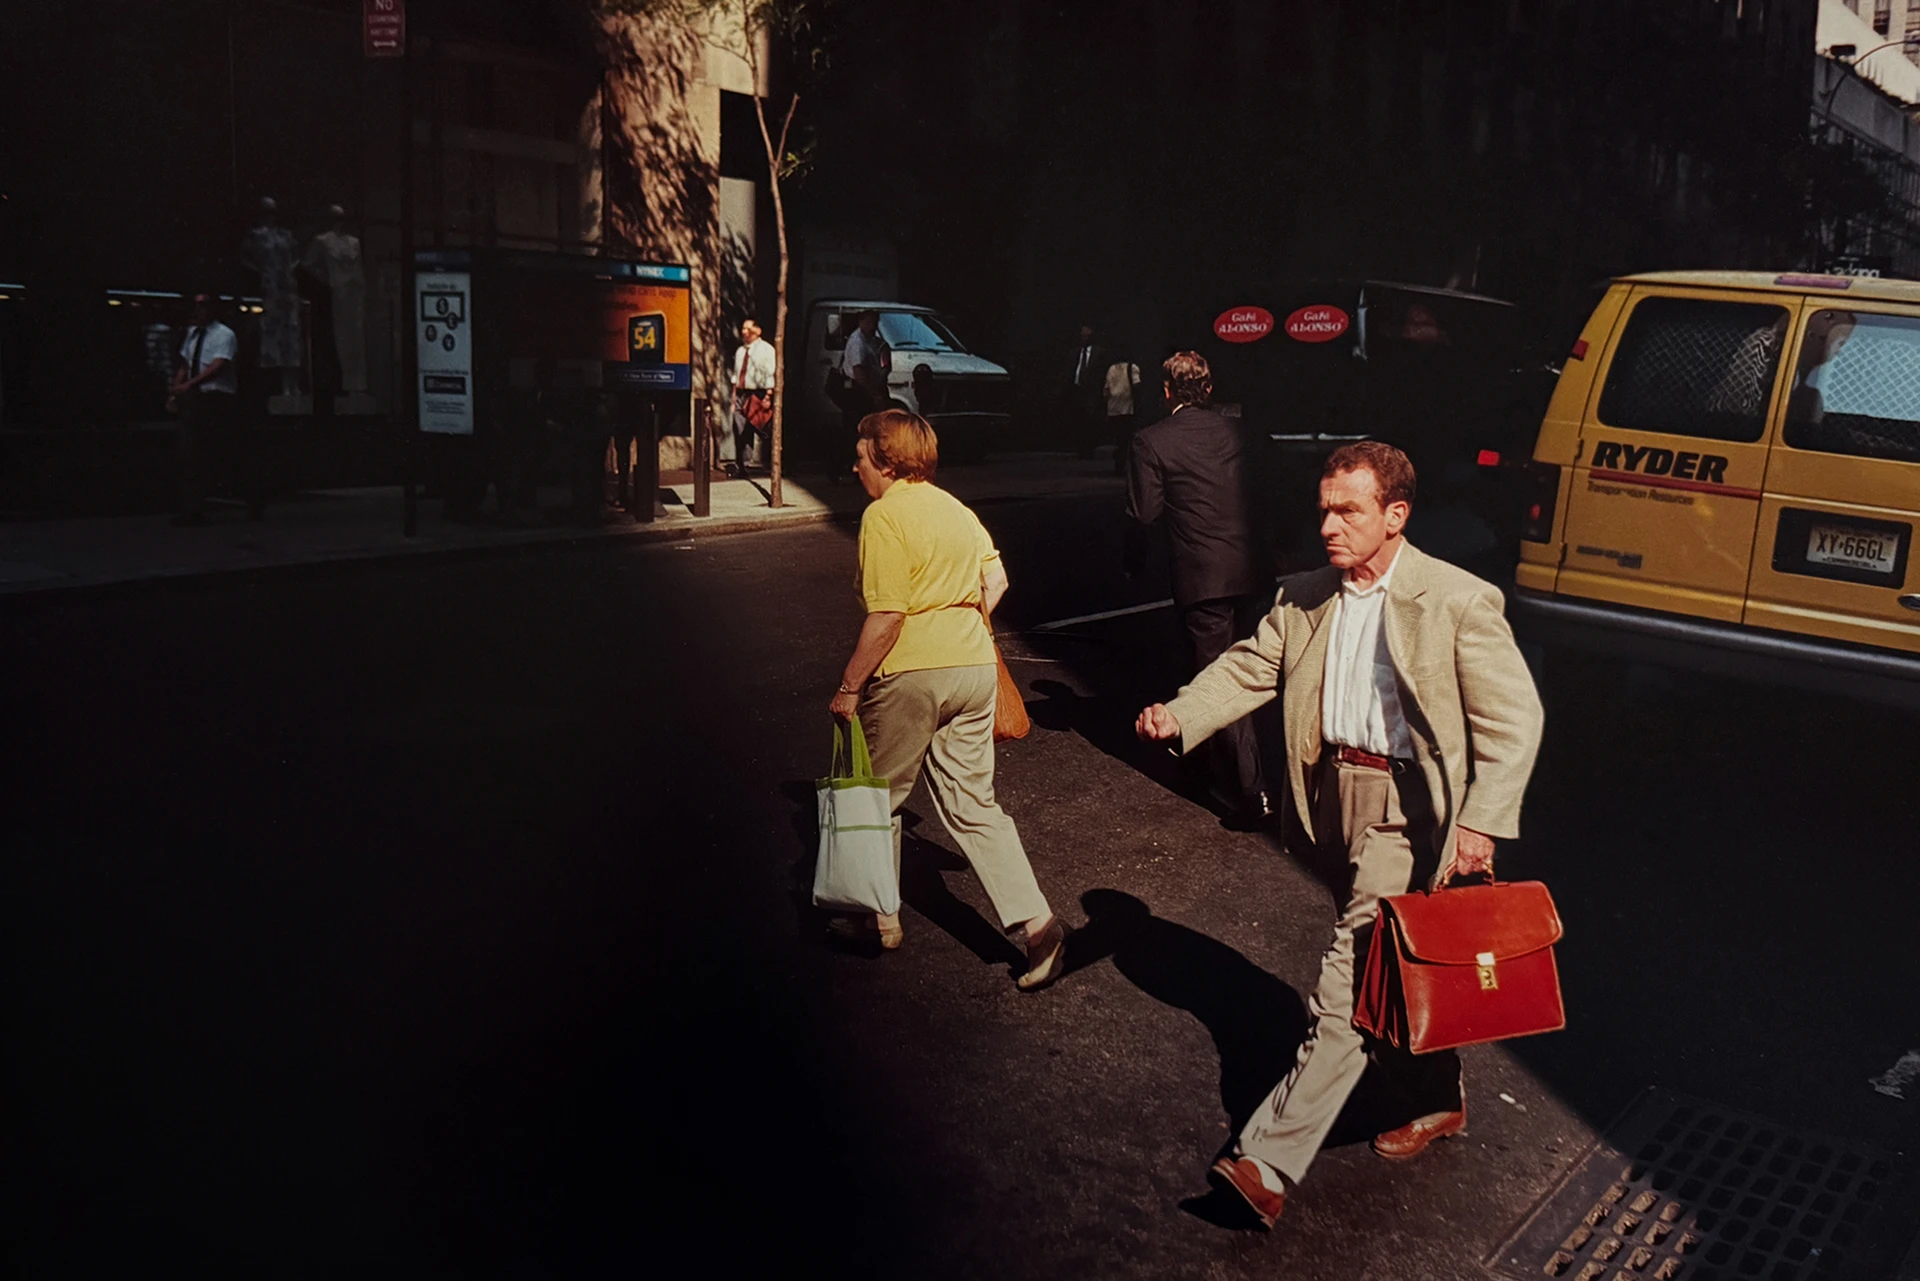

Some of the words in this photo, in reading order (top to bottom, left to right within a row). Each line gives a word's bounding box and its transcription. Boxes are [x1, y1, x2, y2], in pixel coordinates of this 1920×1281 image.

[375, 0, 394, 11] NO
[1218, 322, 1267, 333] ALONSO
[1290, 322, 1342, 333] ALONSO
[633, 326, 656, 349] 54
[1592, 441, 1728, 484] RYDER
